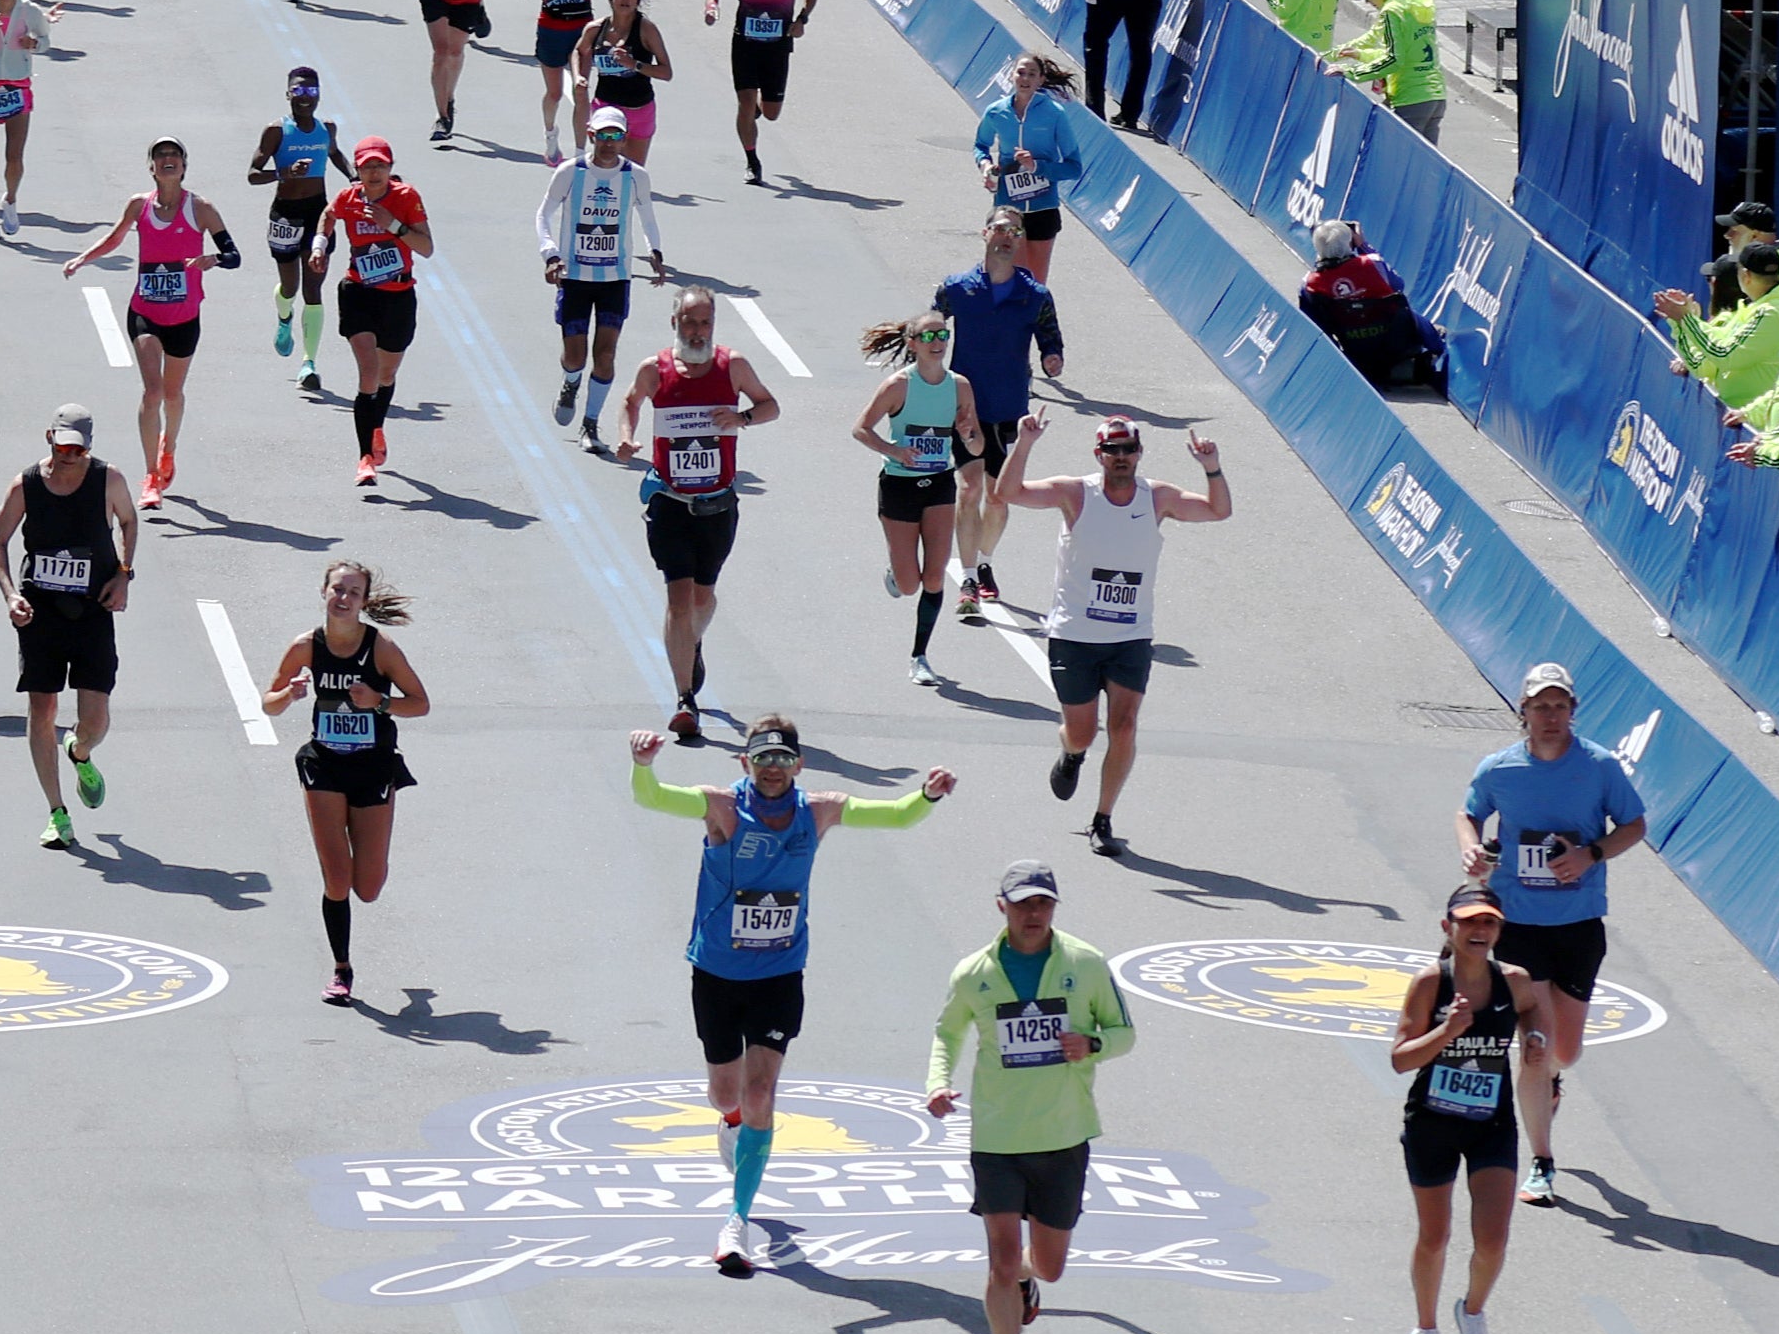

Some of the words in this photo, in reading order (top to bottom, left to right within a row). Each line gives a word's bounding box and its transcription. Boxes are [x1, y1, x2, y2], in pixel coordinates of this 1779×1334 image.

[1660, 111, 1705, 186] adidas
[583, 206, 620, 218] DAVID
[580, 235, 616, 252] 12900
[361, 251, 398, 275] 17009
[144, 274, 182, 291] 20763
[674, 451, 715, 469] 12401
[41, 557, 84, 578] 11716
[1095, 583, 1136, 606] 10300
[319, 672, 361, 690] ALICE
[322, 711, 375, 744] 16620
[740, 907, 792, 929] 15479
[1139, 944, 1278, 983] BOSTON
[1182, 994, 1322, 1024] 126th
[1005, 1018, 1063, 1044] 14258
[1454, 1036, 1497, 1049] PAULA
[1441, 1048, 1475, 1060] COSTA
[1477, 1047, 1505, 1059] RICA
[1440, 1069, 1494, 1097] 16425
[497, 1105, 562, 1157] BOSTON
[346, 1163, 631, 1191] 126TH
[652, 1158, 1182, 1190] BOSTN
[355, 1184, 1202, 1214] MARATHN
[369, 1234, 716, 1297] John
